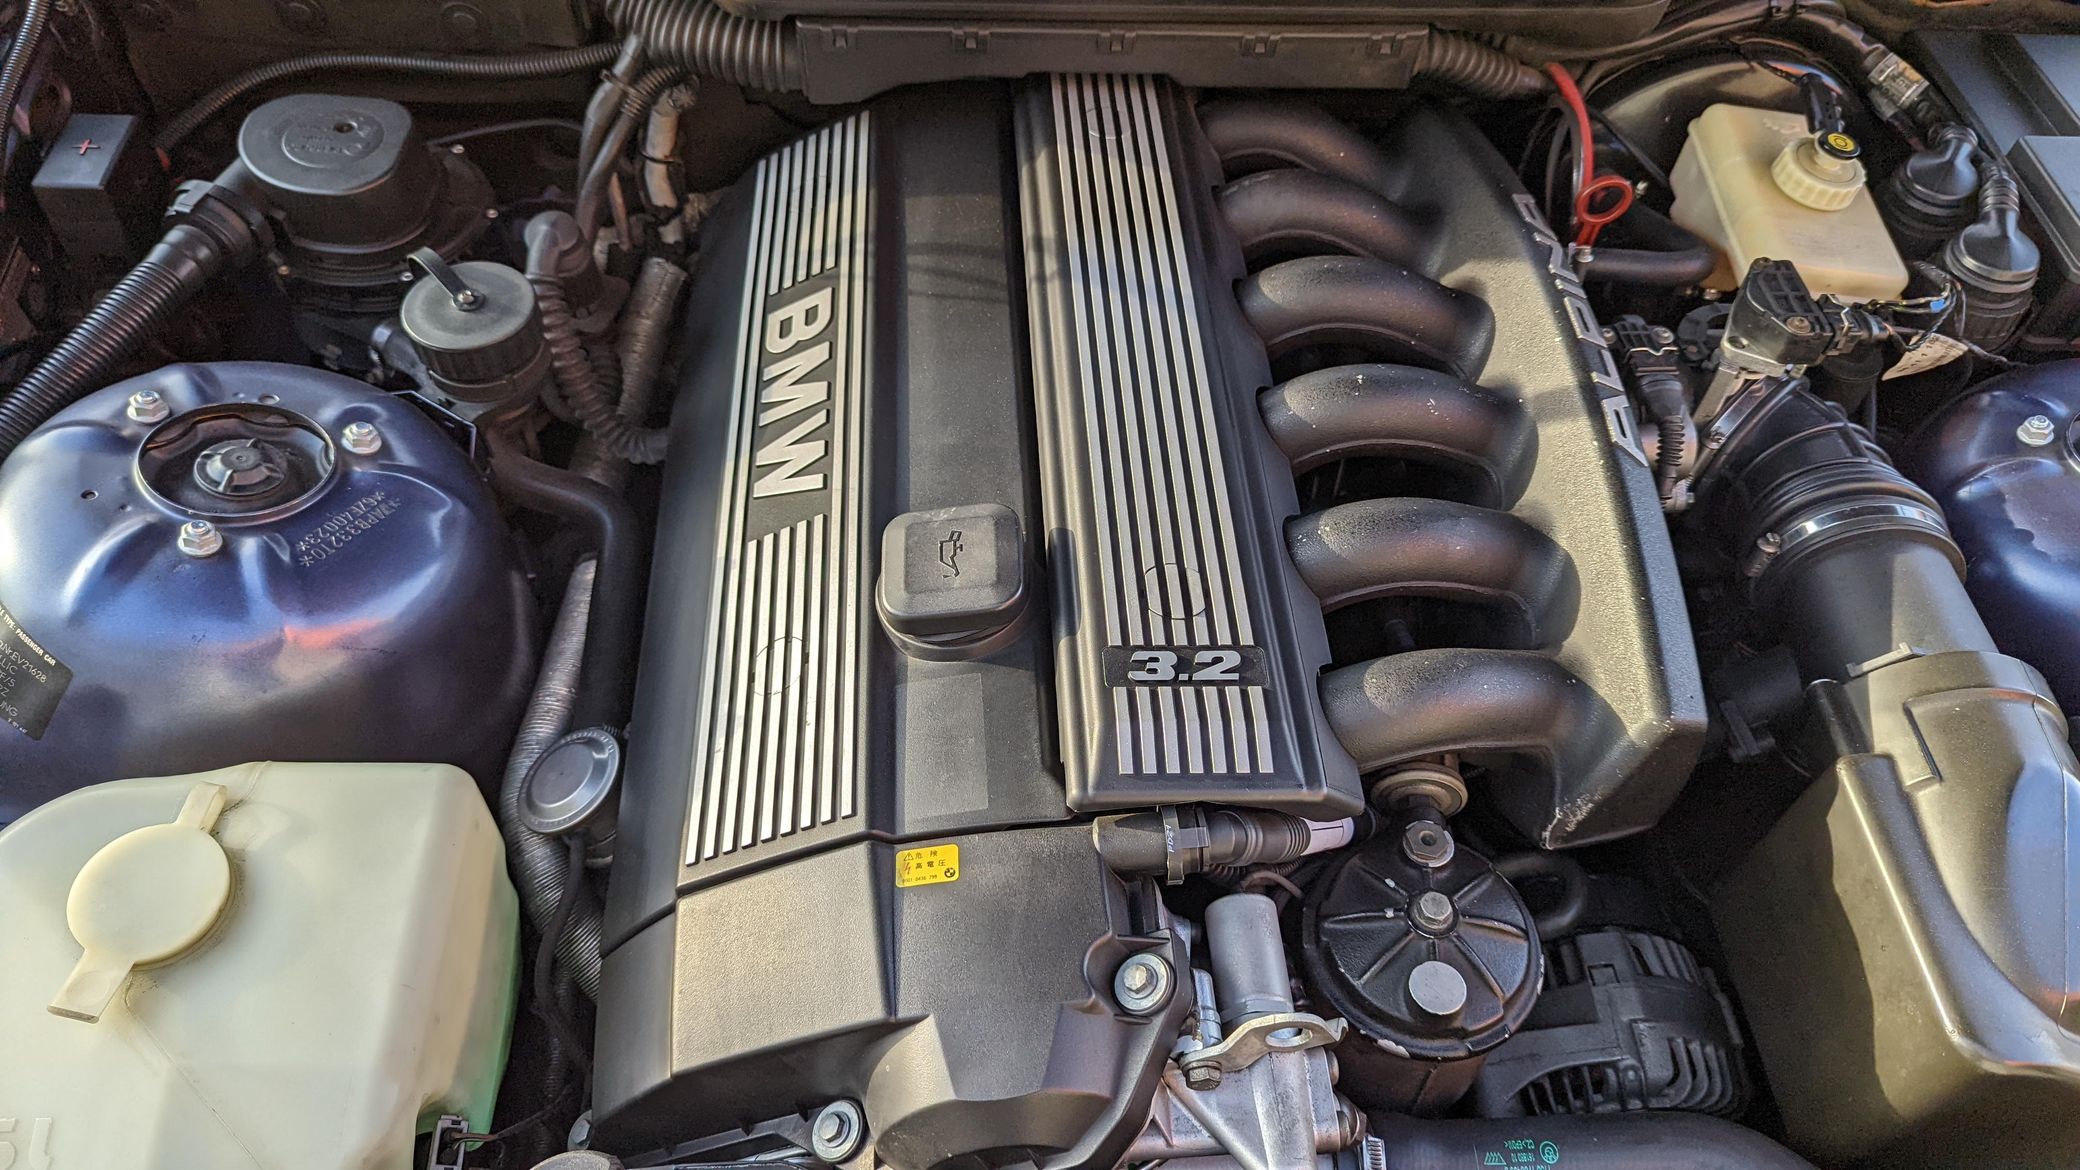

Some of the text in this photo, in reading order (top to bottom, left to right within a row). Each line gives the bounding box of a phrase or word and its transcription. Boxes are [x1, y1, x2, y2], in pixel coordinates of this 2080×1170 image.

[753, 286, 833, 498] BMW
[1513, 194, 1648, 466] ALPINA
[15, 628, 44, 656] PASSENGER
[44, 653, 57, 667] CAR
[1128, 650, 1241, 681] 3.2
